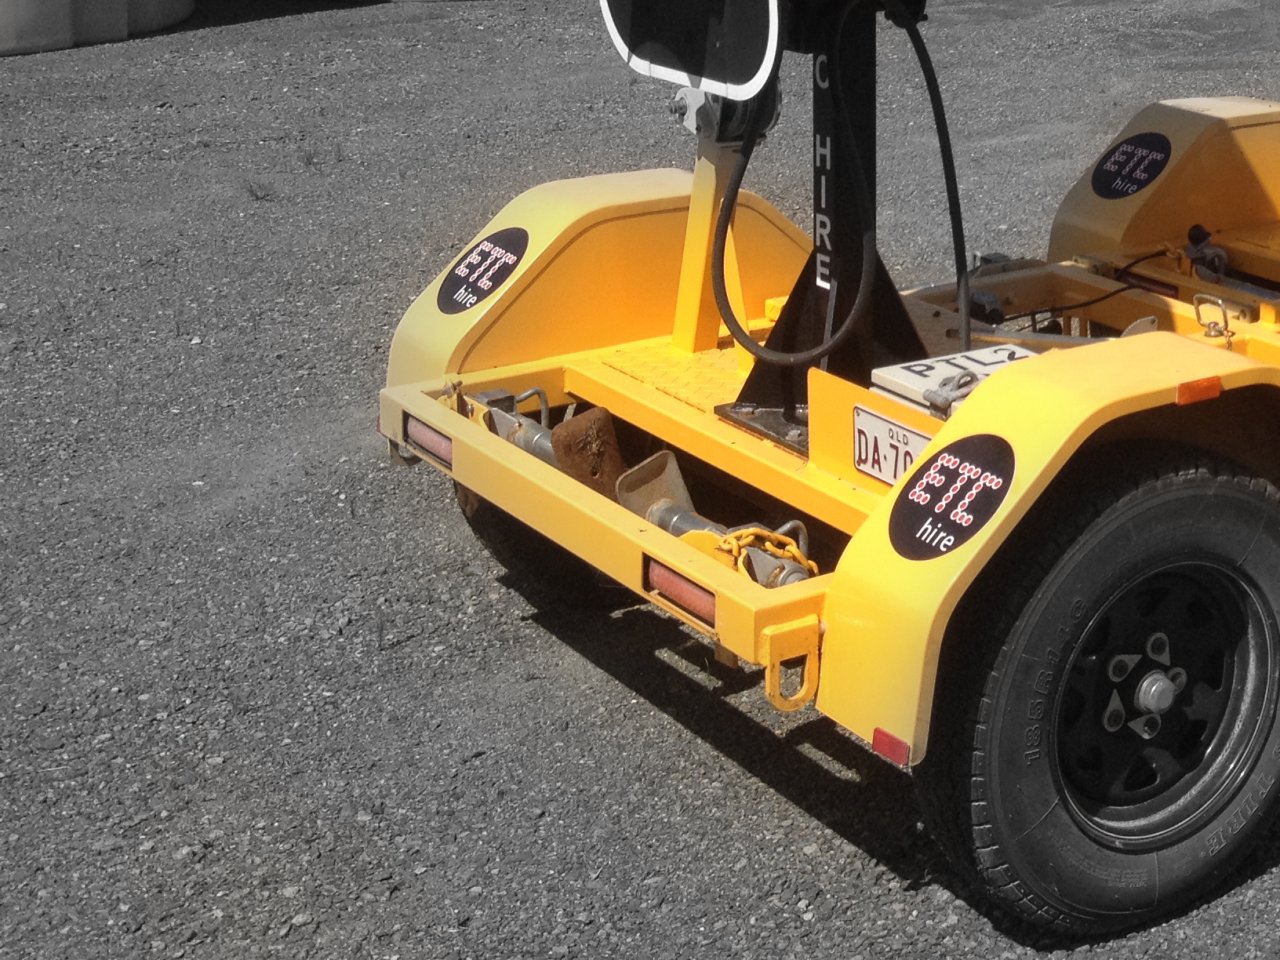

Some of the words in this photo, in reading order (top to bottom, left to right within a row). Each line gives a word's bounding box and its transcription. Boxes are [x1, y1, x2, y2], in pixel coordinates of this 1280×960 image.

[1103, 144, 1166, 181] ETC
[1111, 177, 1138, 194] hire
[815, 133, 832, 290] HIRE
[455, 240, 518, 291] ETC
[453, 284, 478, 308] hire
[888, 428, 909, 446] QLD
[908, 453, 1003, 527] ETC
[916, 517, 955, 552] hire
